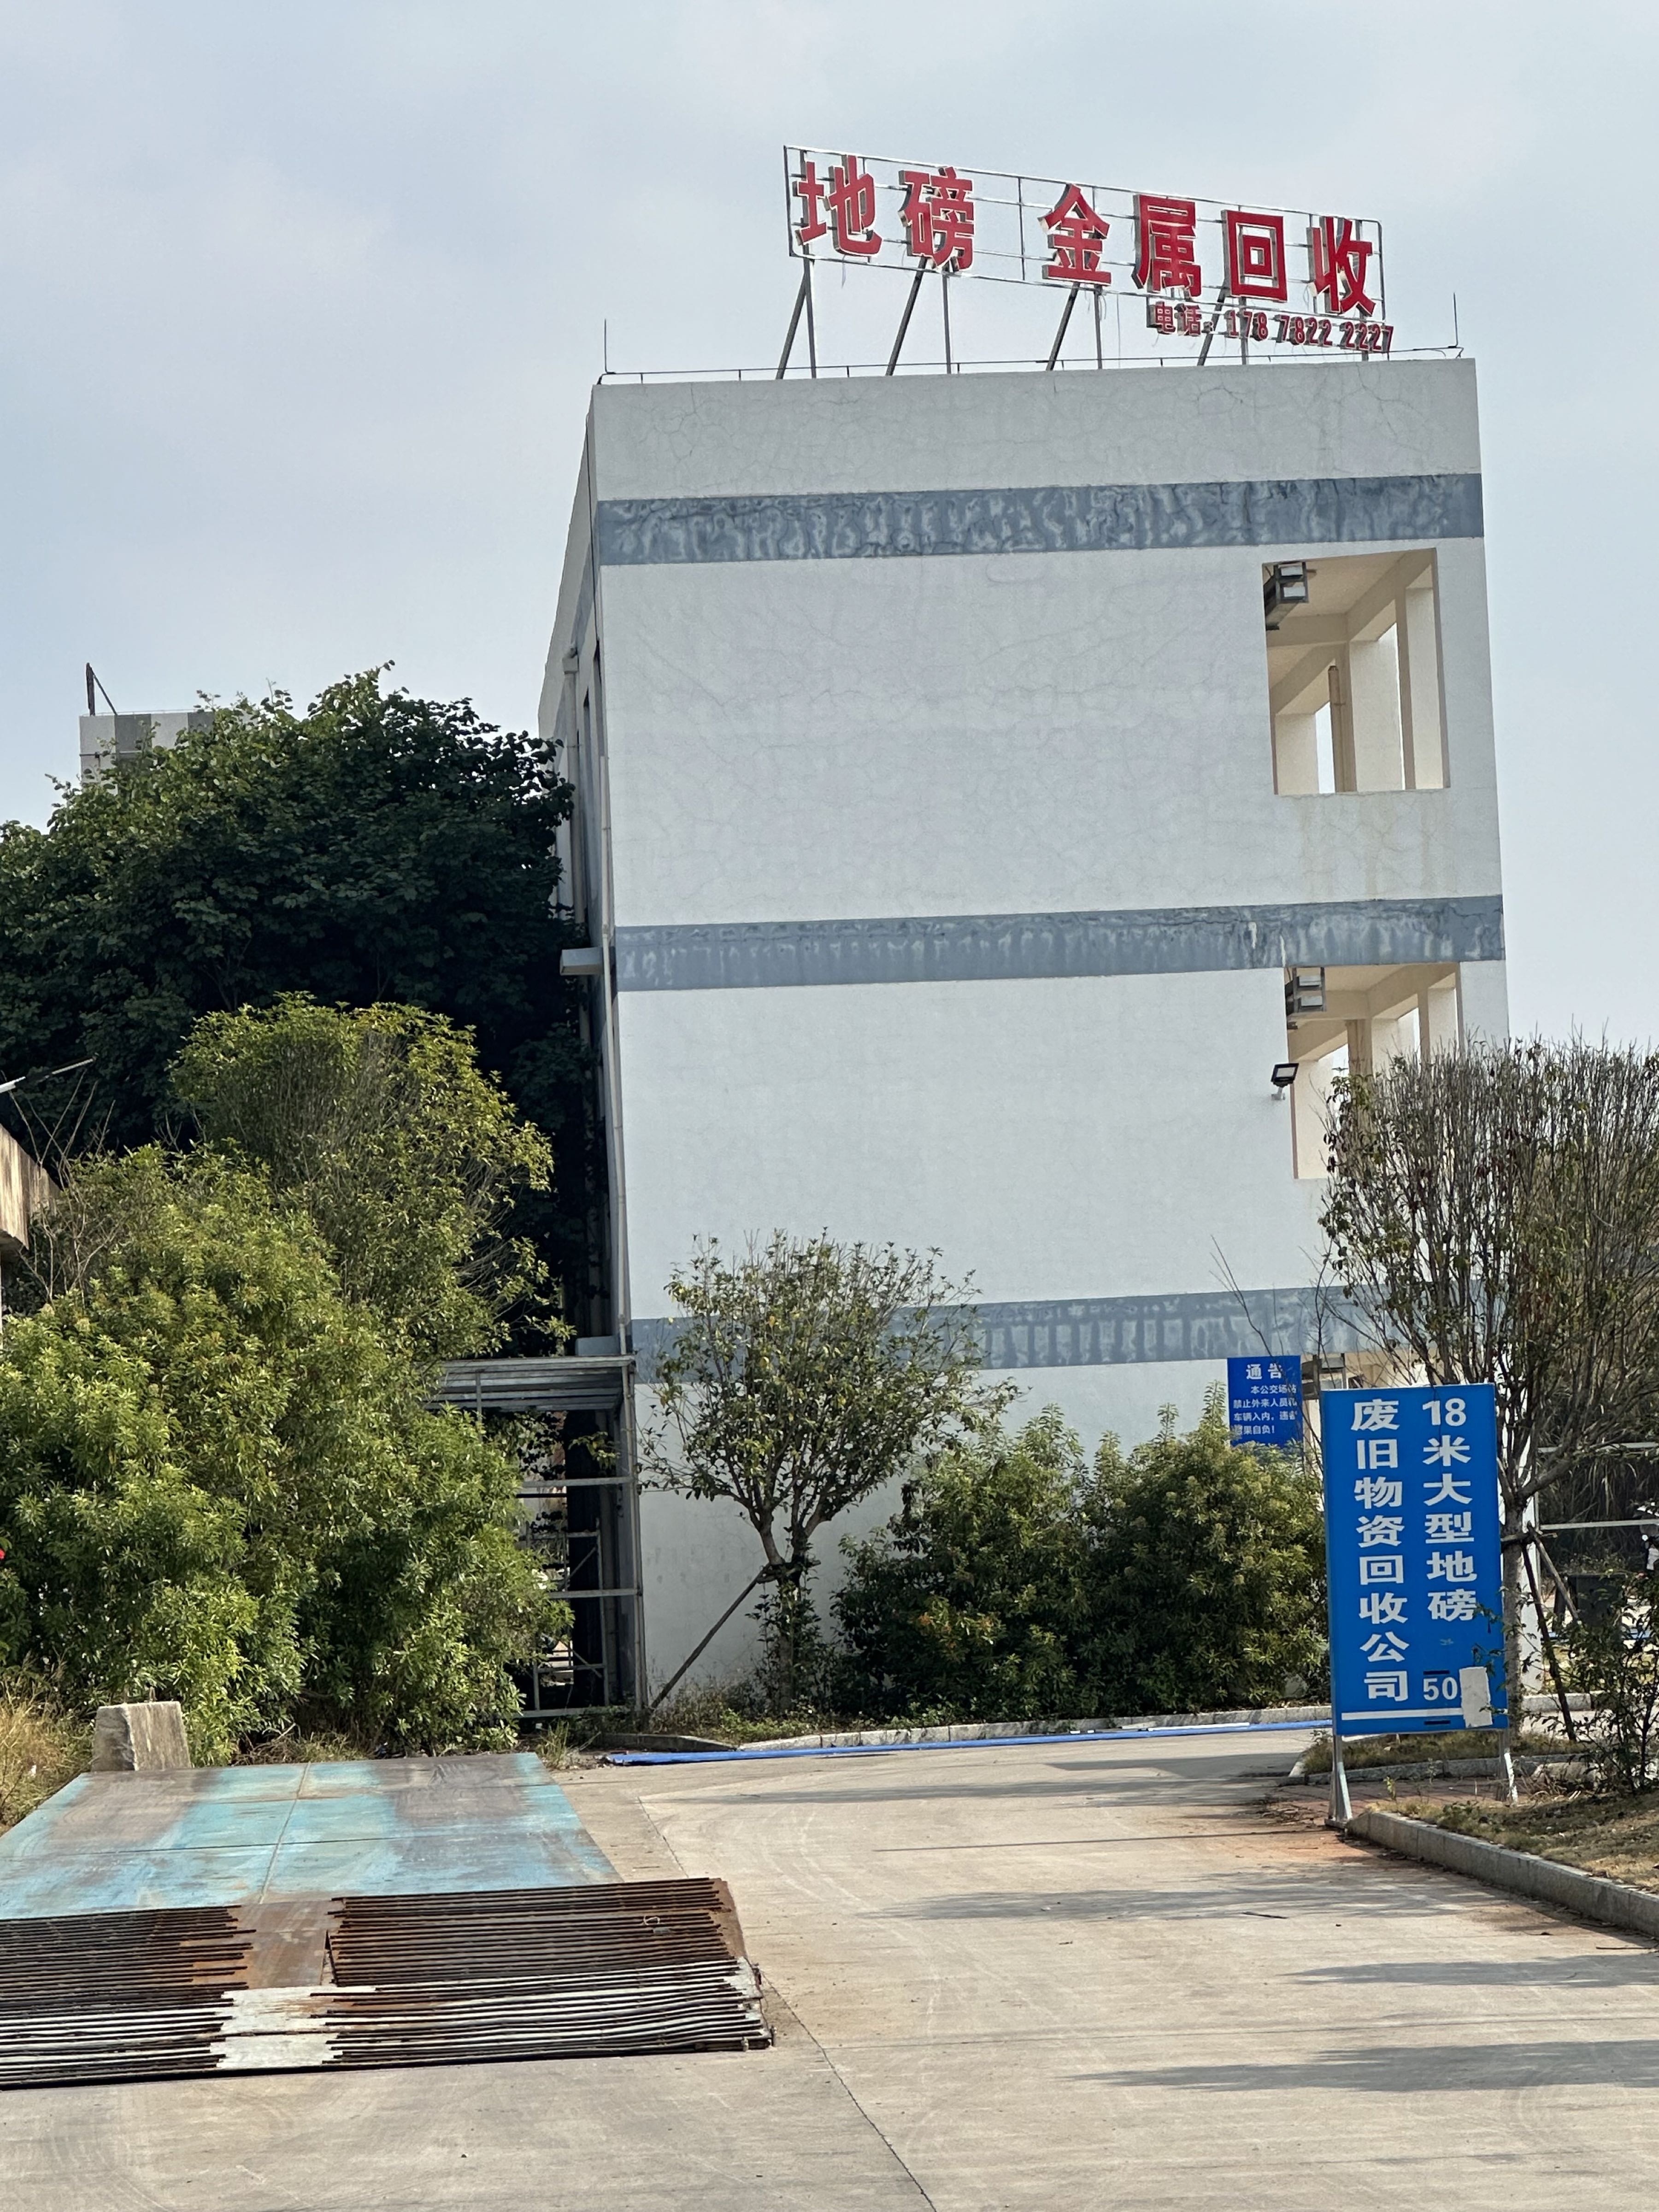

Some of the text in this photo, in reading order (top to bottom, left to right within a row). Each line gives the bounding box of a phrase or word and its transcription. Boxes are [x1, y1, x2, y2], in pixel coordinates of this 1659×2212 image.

[793, 154, 1376, 317] 地磅 金属回收
[1226, 310, 1269, 341] 178
[1277, 315, 1332, 347] 7822
[1342, 322, 1394, 353] 2227
[1246, 1363, 1282, 1380] 通告
[1250, 1384, 1297, 1394] 本公交场站
[1351, 1398, 1409, 1702] 废旧物资回收公司
[1422, 1397, 1477, 1623] 18米大型地磅
